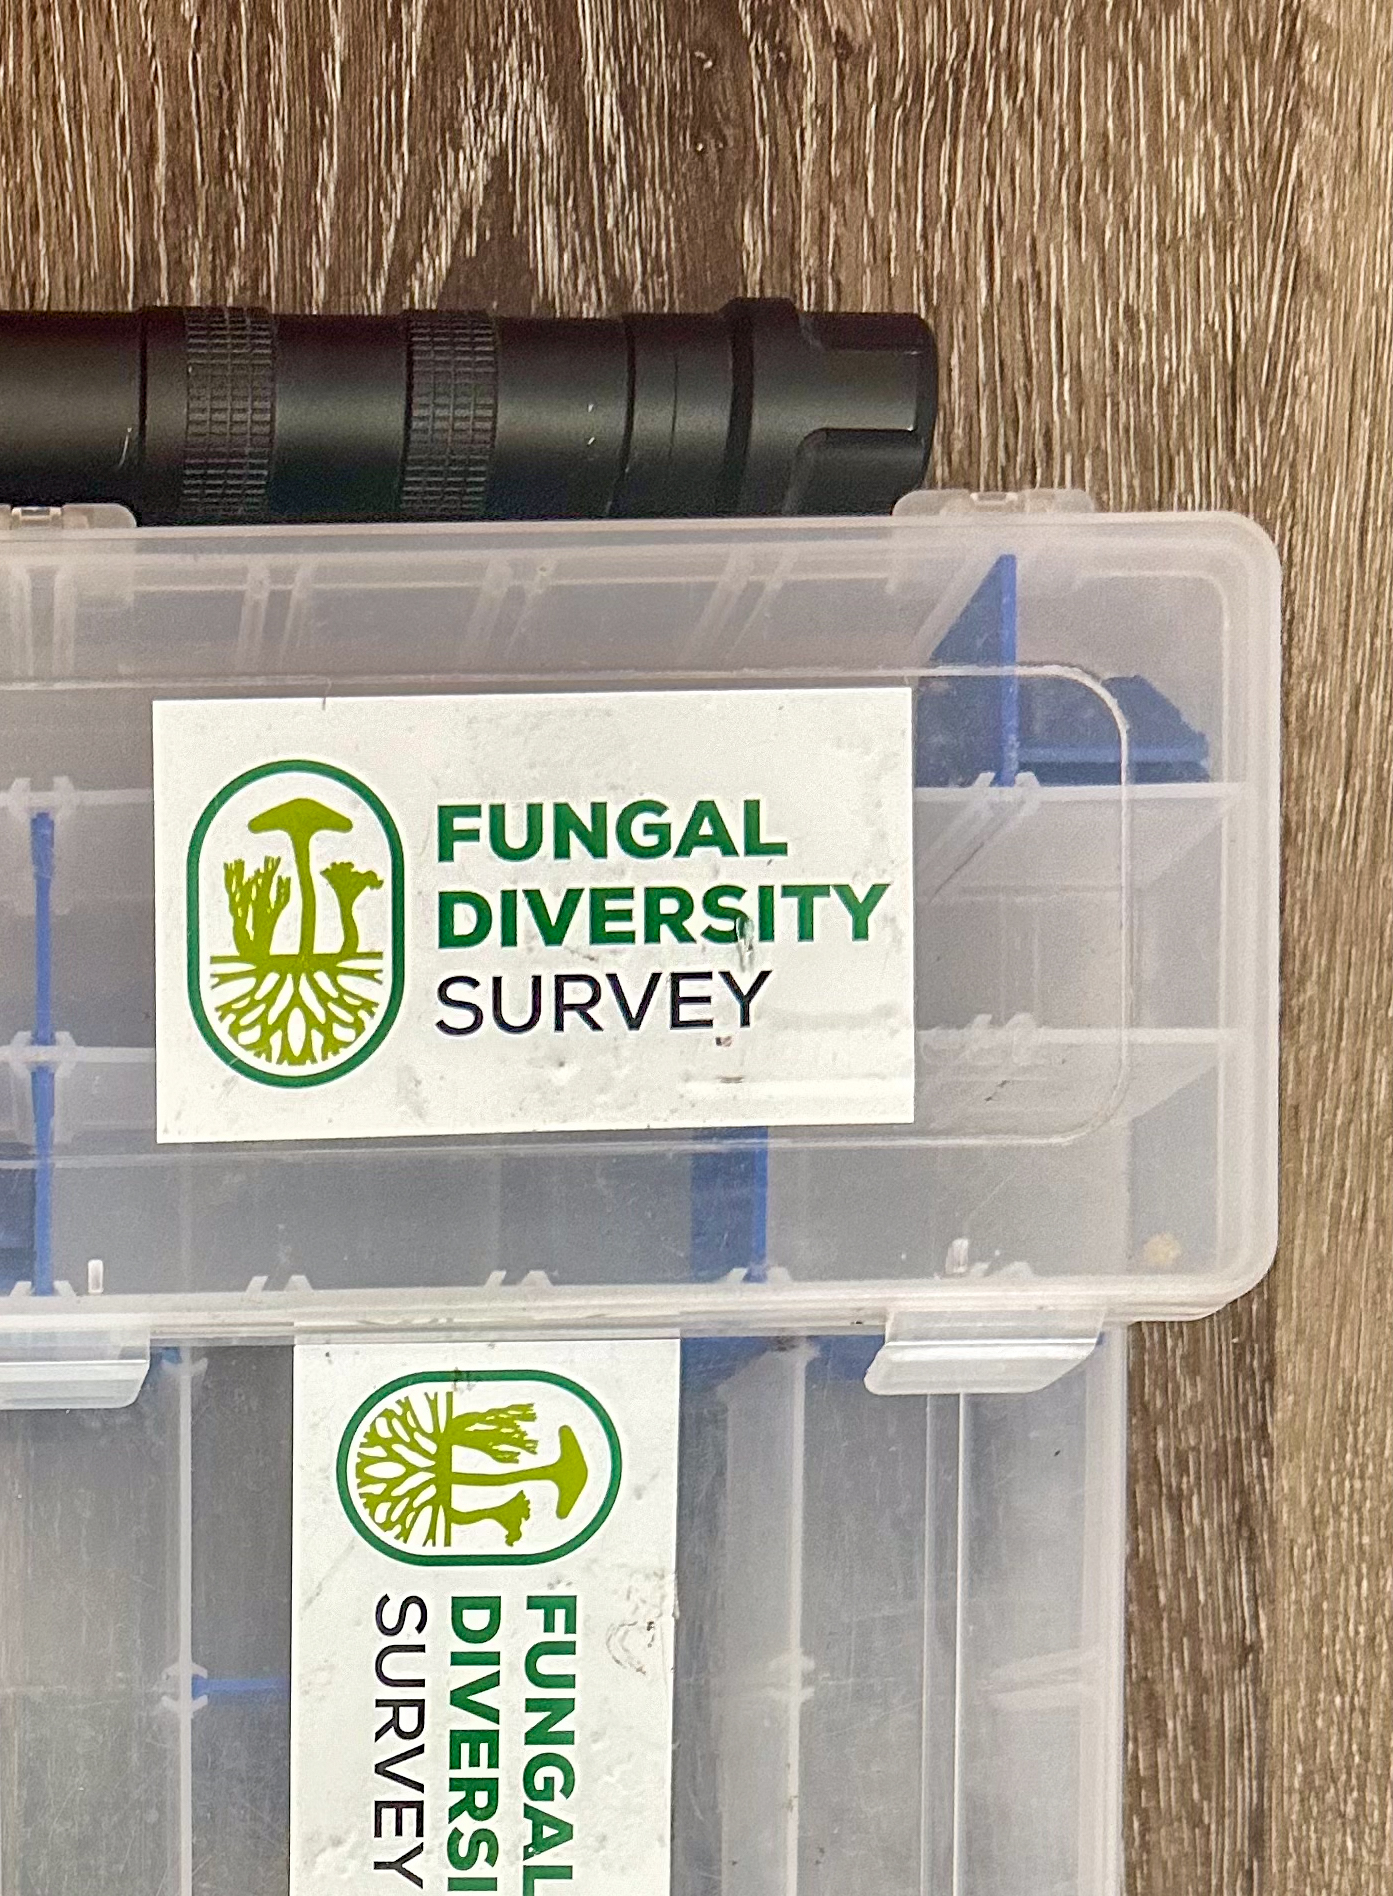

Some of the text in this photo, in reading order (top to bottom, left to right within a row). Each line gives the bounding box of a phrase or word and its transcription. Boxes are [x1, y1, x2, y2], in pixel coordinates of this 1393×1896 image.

[436, 798, 788, 863] FUNGAL
[436, 883, 891, 950] DIVERSITY
[434, 969, 773, 1036] SURVEY
[373, 1593, 428, 1890] SURVEY
